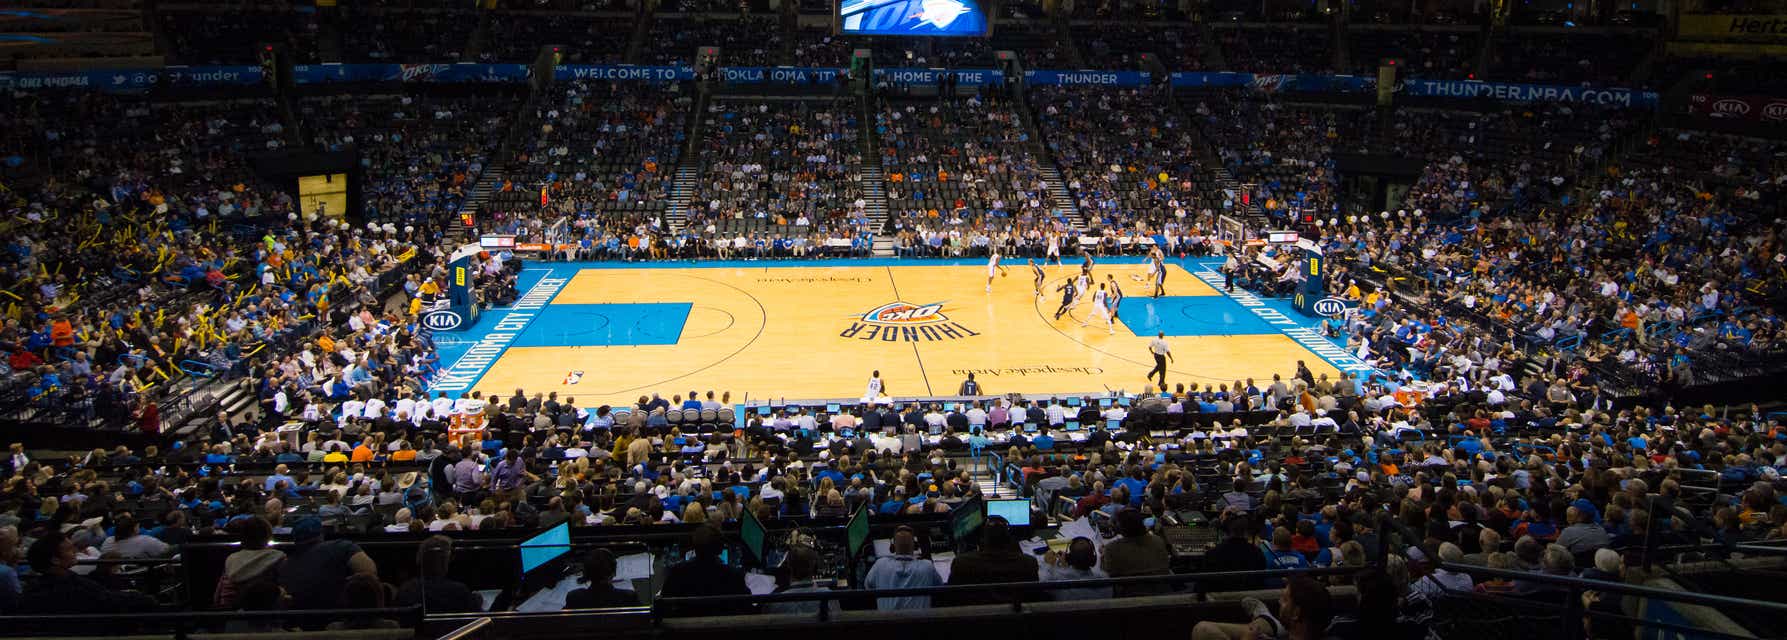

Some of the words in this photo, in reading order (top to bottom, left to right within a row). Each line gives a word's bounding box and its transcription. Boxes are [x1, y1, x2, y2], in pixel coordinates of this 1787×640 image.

[574, 67, 650, 79] WELCOME
[656, 68, 676, 79] TO
[893, 71, 932, 82] HOME
[958, 72, 983, 83] THE
[1057, 73, 1118, 84] THUNDER
[1319, 302, 1341, 313] KIA
[429, 315, 454, 327] KIA
[839, 321, 981, 342] THUNDER
[1004, 365, 1104, 376] Chesapeake
